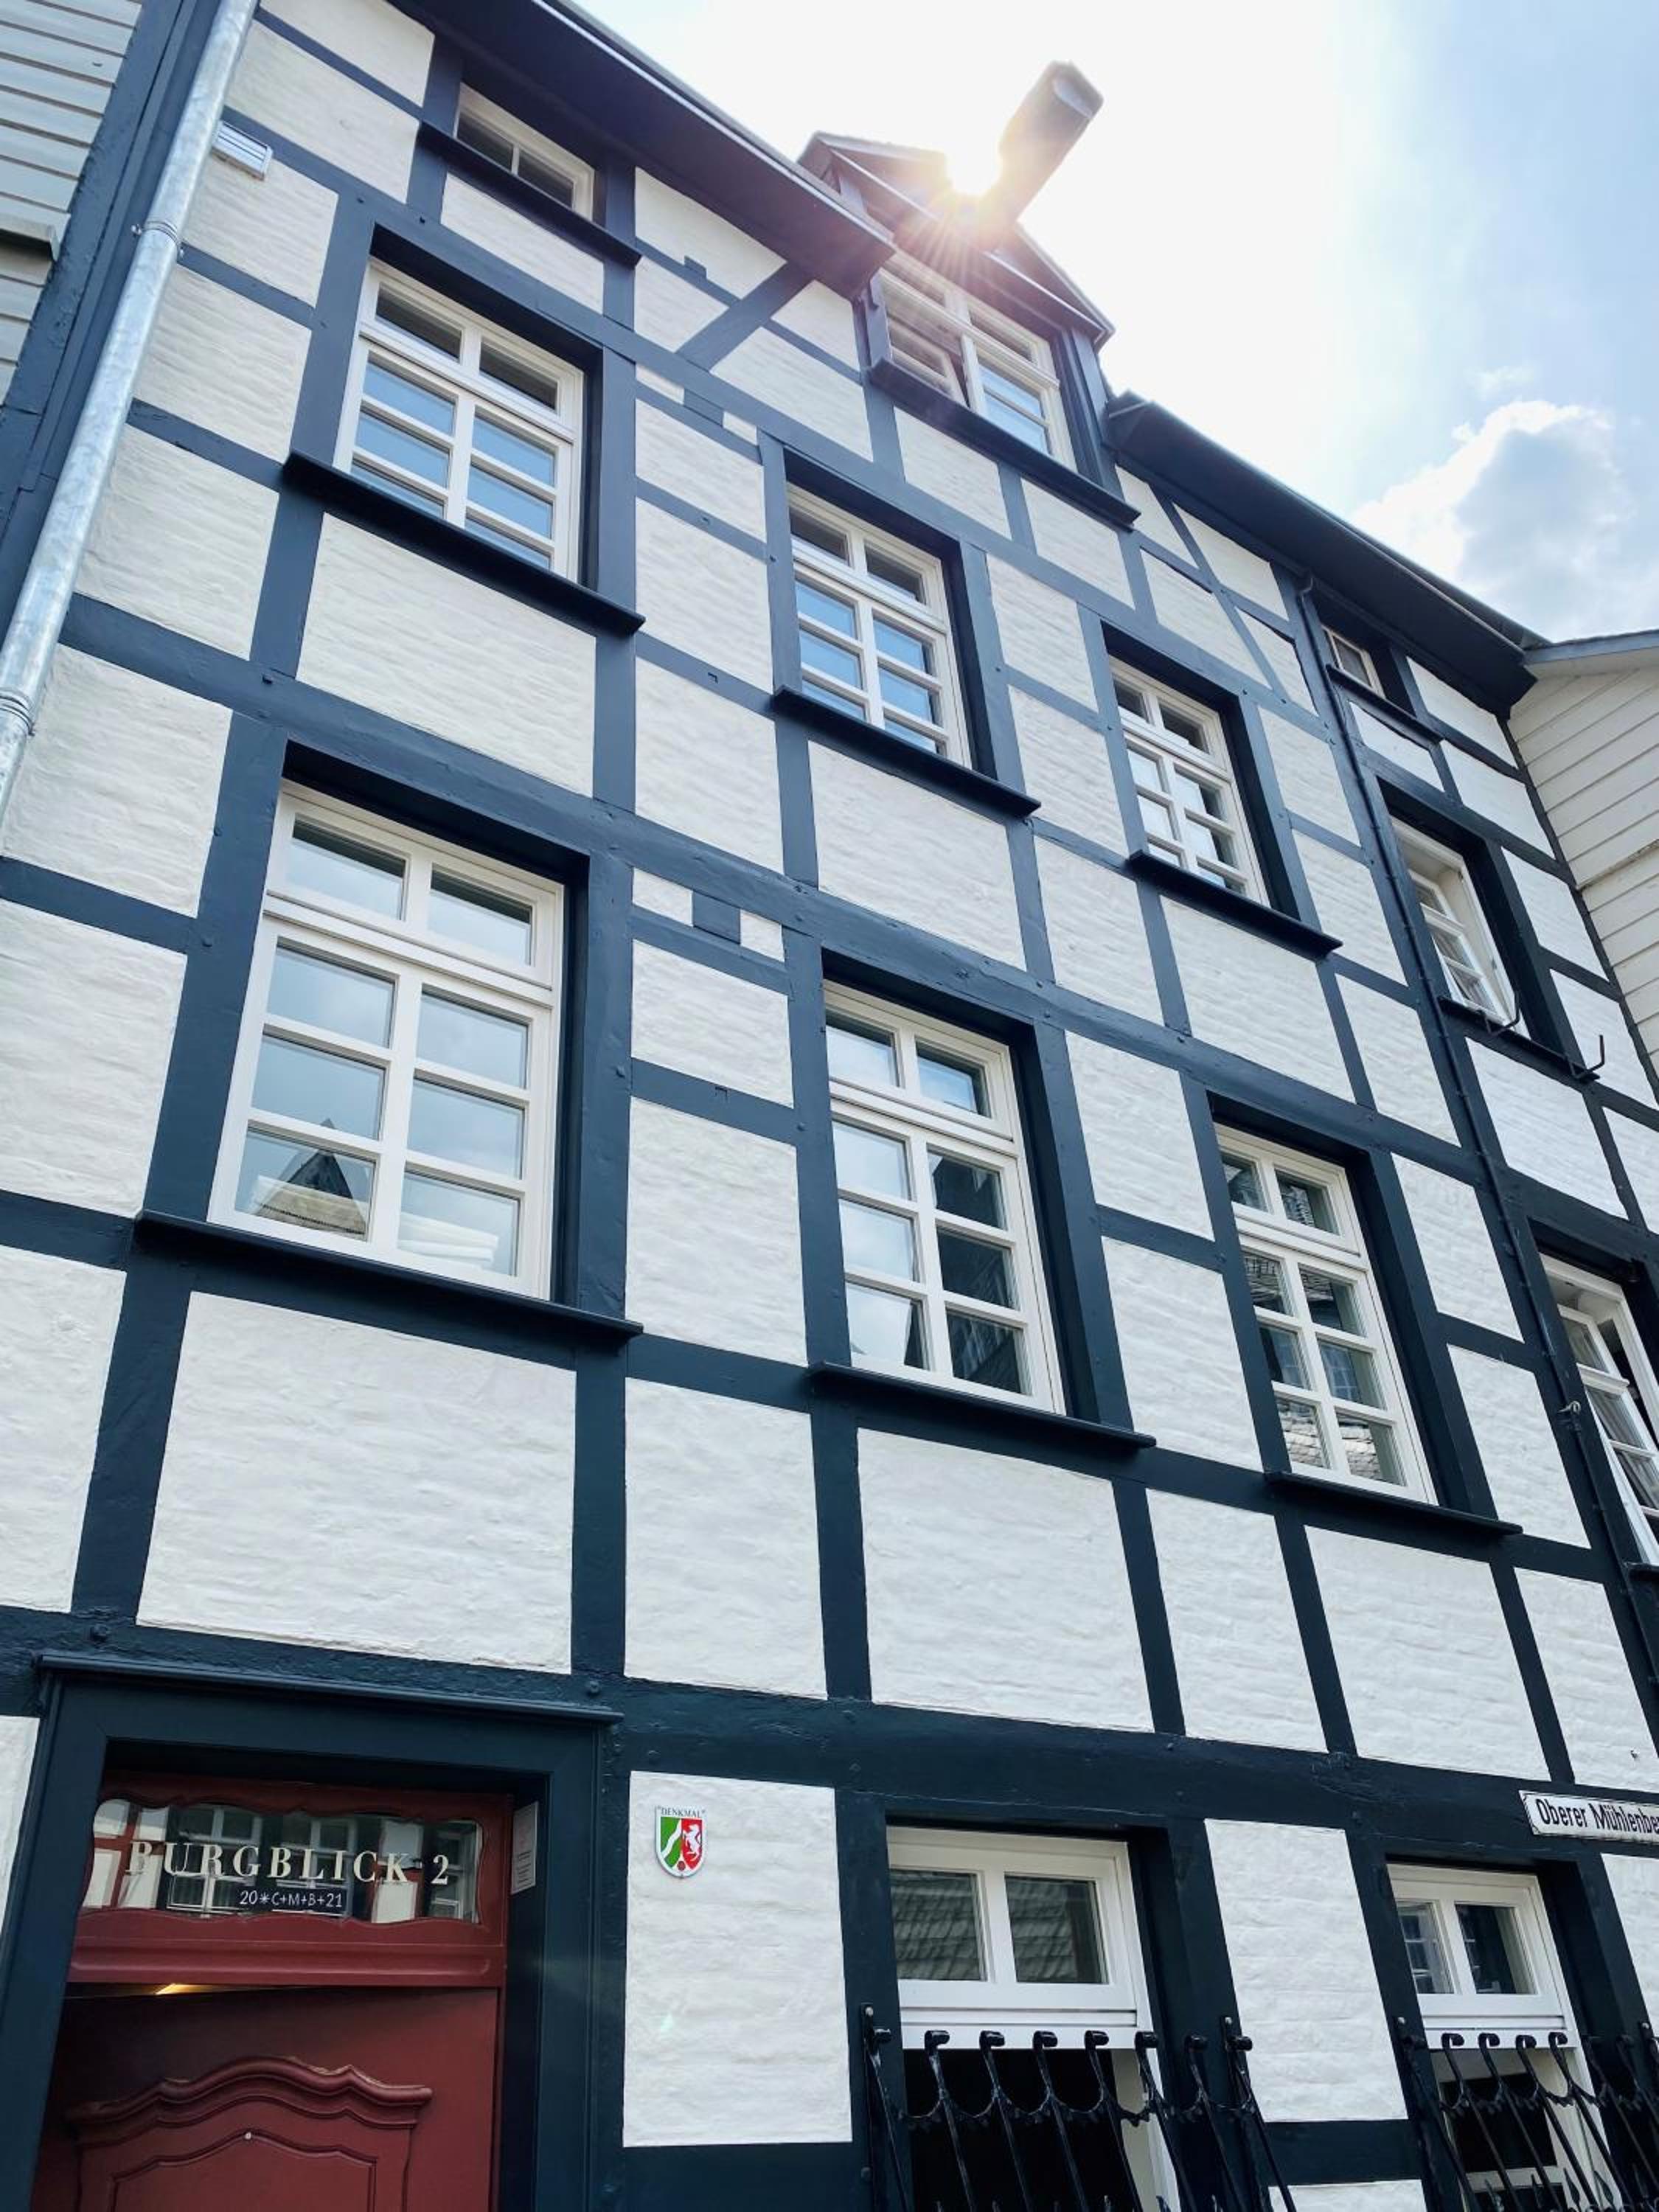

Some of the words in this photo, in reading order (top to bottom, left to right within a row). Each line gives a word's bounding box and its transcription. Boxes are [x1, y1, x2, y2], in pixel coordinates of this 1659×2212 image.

[661, 1807, 700, 1818] DENKMAL
[1536, 1798, 1588, 1827] Oberer
[125, 1840, 409, 1883] BURGBLICK
[431, 1854, 449, 1885] 2
